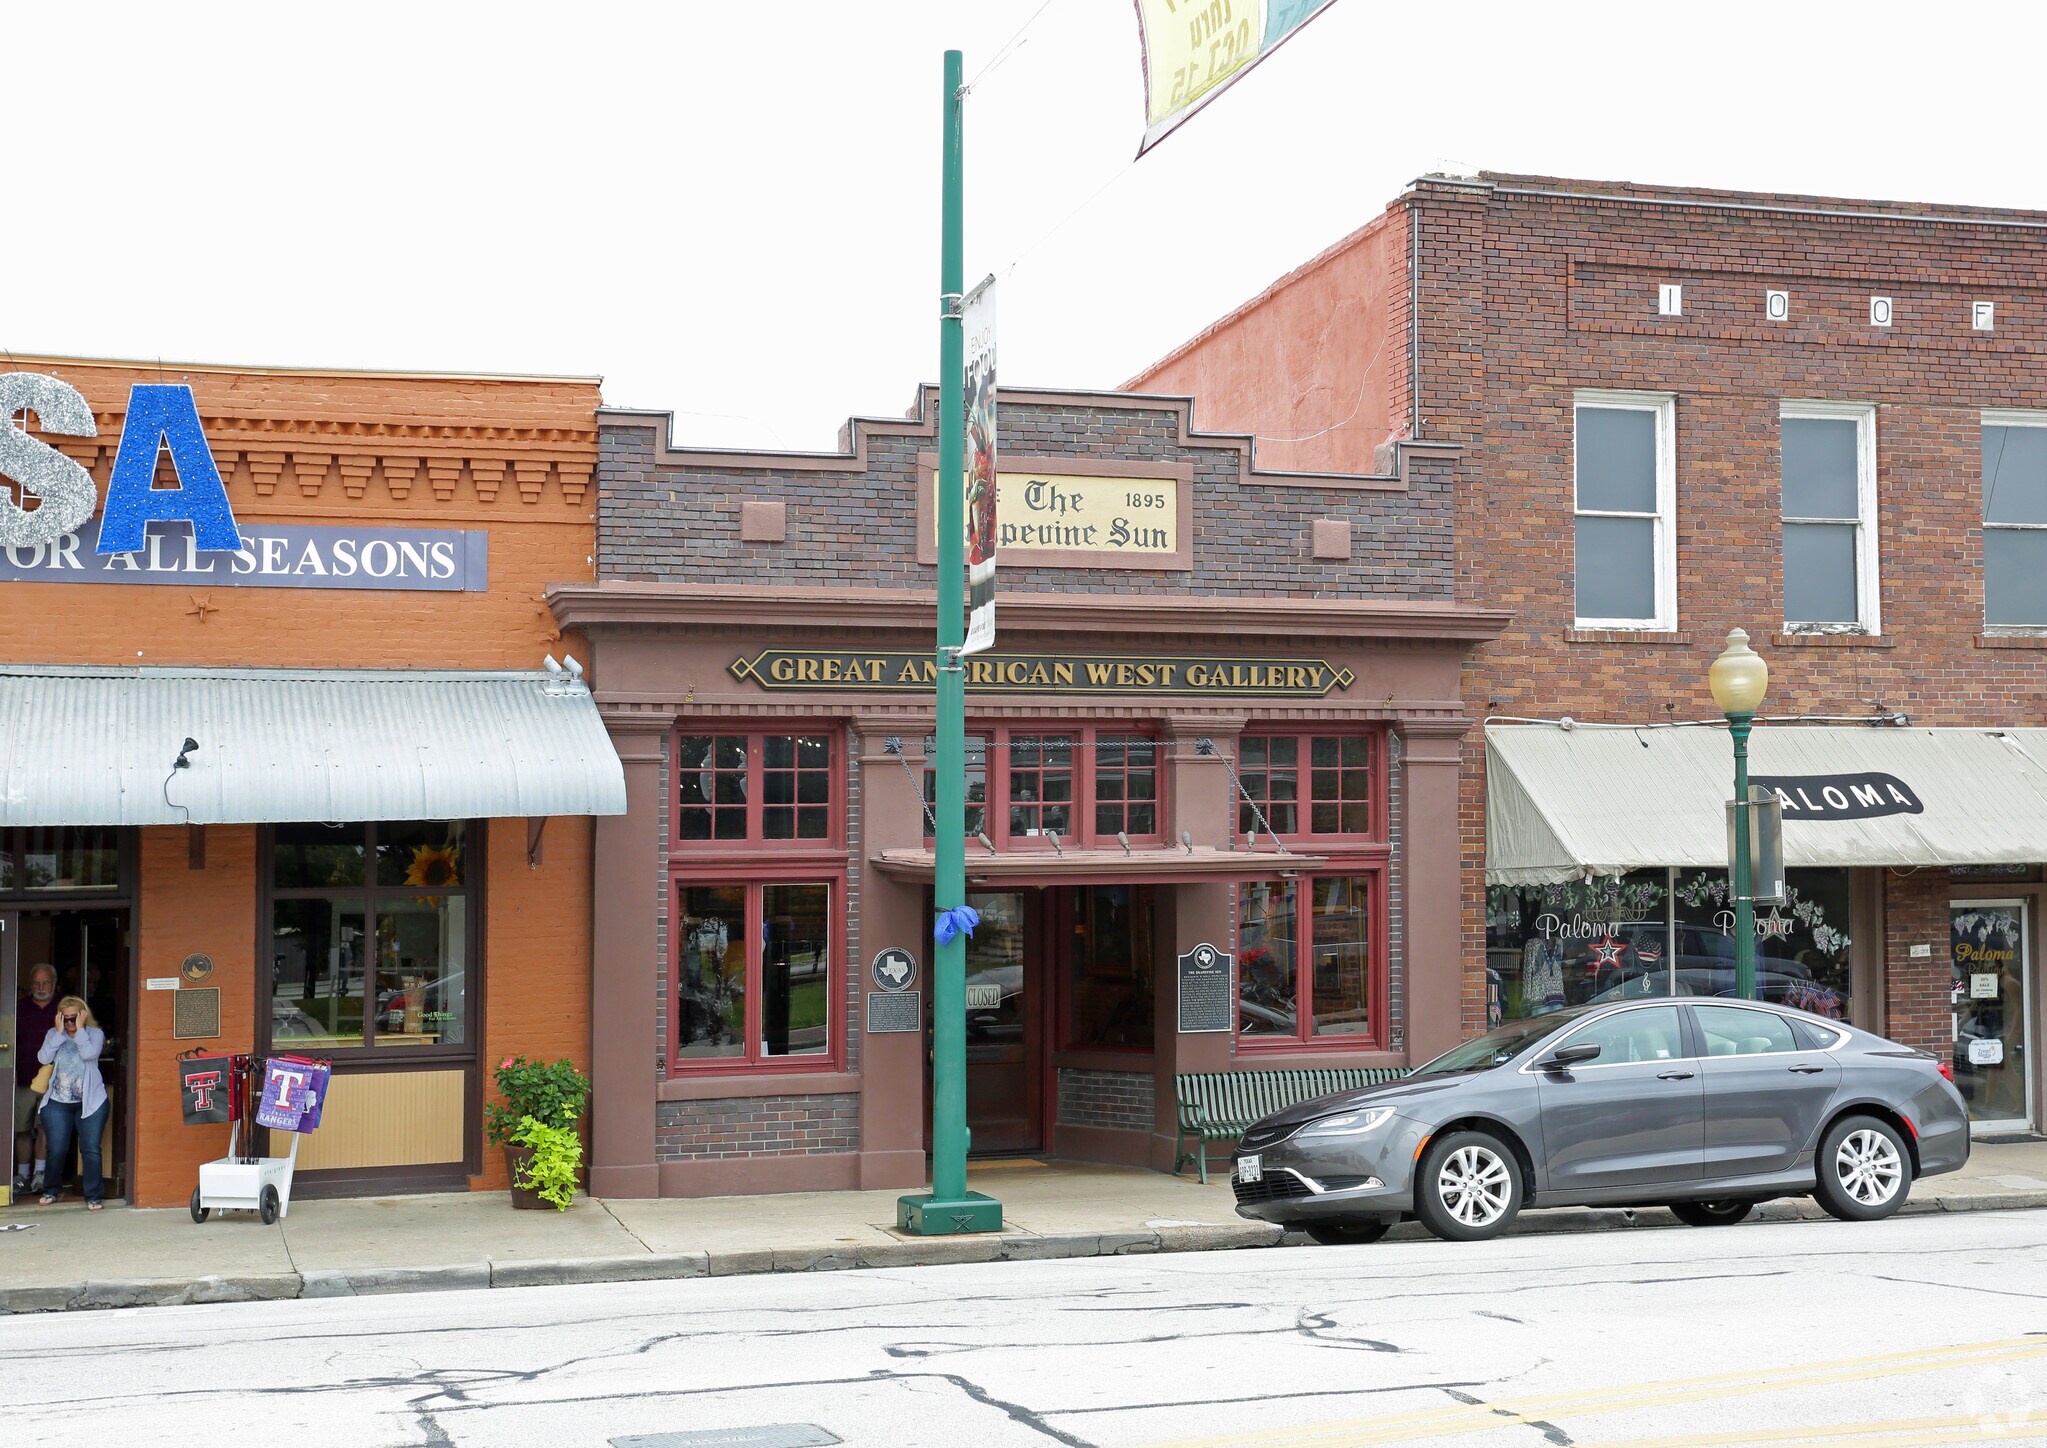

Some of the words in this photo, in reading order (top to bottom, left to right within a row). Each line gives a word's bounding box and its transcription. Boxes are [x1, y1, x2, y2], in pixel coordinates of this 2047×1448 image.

[1769, 293, 1786, 318] O
[1874, 299, 1890, 324] O
[1975, 304, 1992, 328] F
[1024, 480, 1084, 516] The
[1125, 492, 1165, 509] 1895
[1105, 517, 1168, 548] Sun
[231, 536, 456, 579] SEASONS
[770, 657, 888, 683] GREAT
[1084, 662, 1177, 686] WEST
[1185, 663, 1326, 688] GALLERY
[1774, 783, 1912, 811] ALOMA
[1535, 913, 1621, 940] Paloma
[1955, 943, 2014, 962] Paloma
[885, 967, 907, 975] TEXAS
[967, 987, 999, 1006] CLOSED
[259, 1113, 297, 1126] RANGERS
